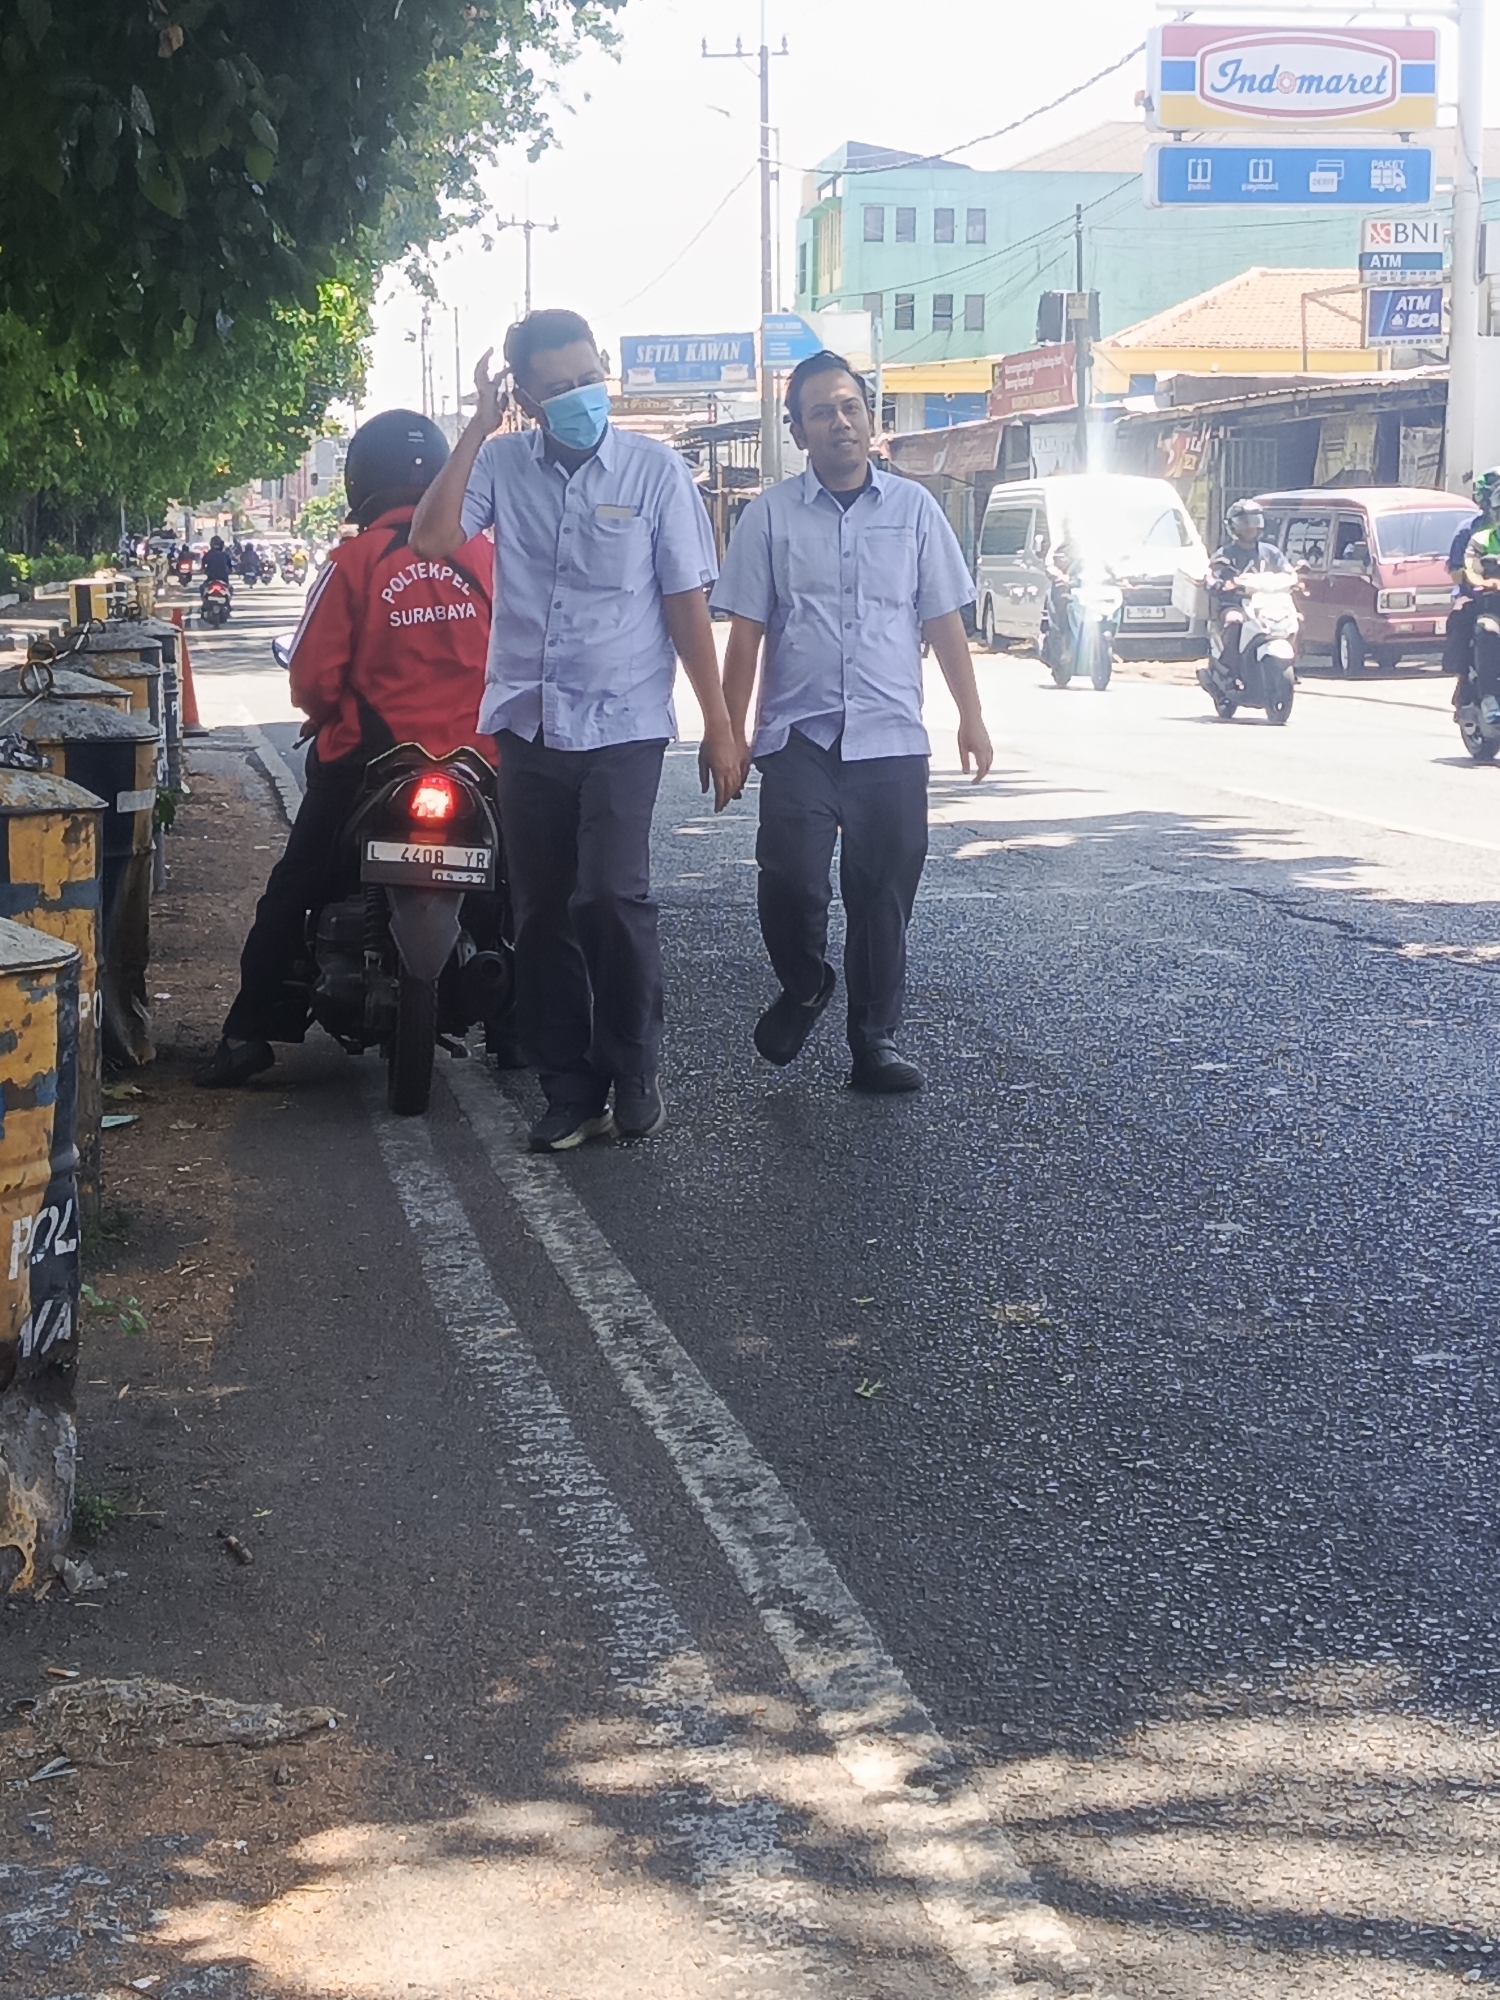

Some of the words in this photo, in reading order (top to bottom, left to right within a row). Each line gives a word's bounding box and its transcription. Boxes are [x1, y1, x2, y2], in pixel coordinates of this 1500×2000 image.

[1210, 58, 1389, 96] Indomaret
[1394, 222, 1438, 243] BNI
[1370, 254, 1402, 268] ATM
[1396, 294, 1432, 311] ATM
[1407, 312, 1439, 328] BCA
[636, 343, 680, 363] SETIA
[685, 341, 740, 361] KAWAN
[381, 562, 470, 604] POLTEKPEL
[389, 602, 477, 627] SURABAYA
